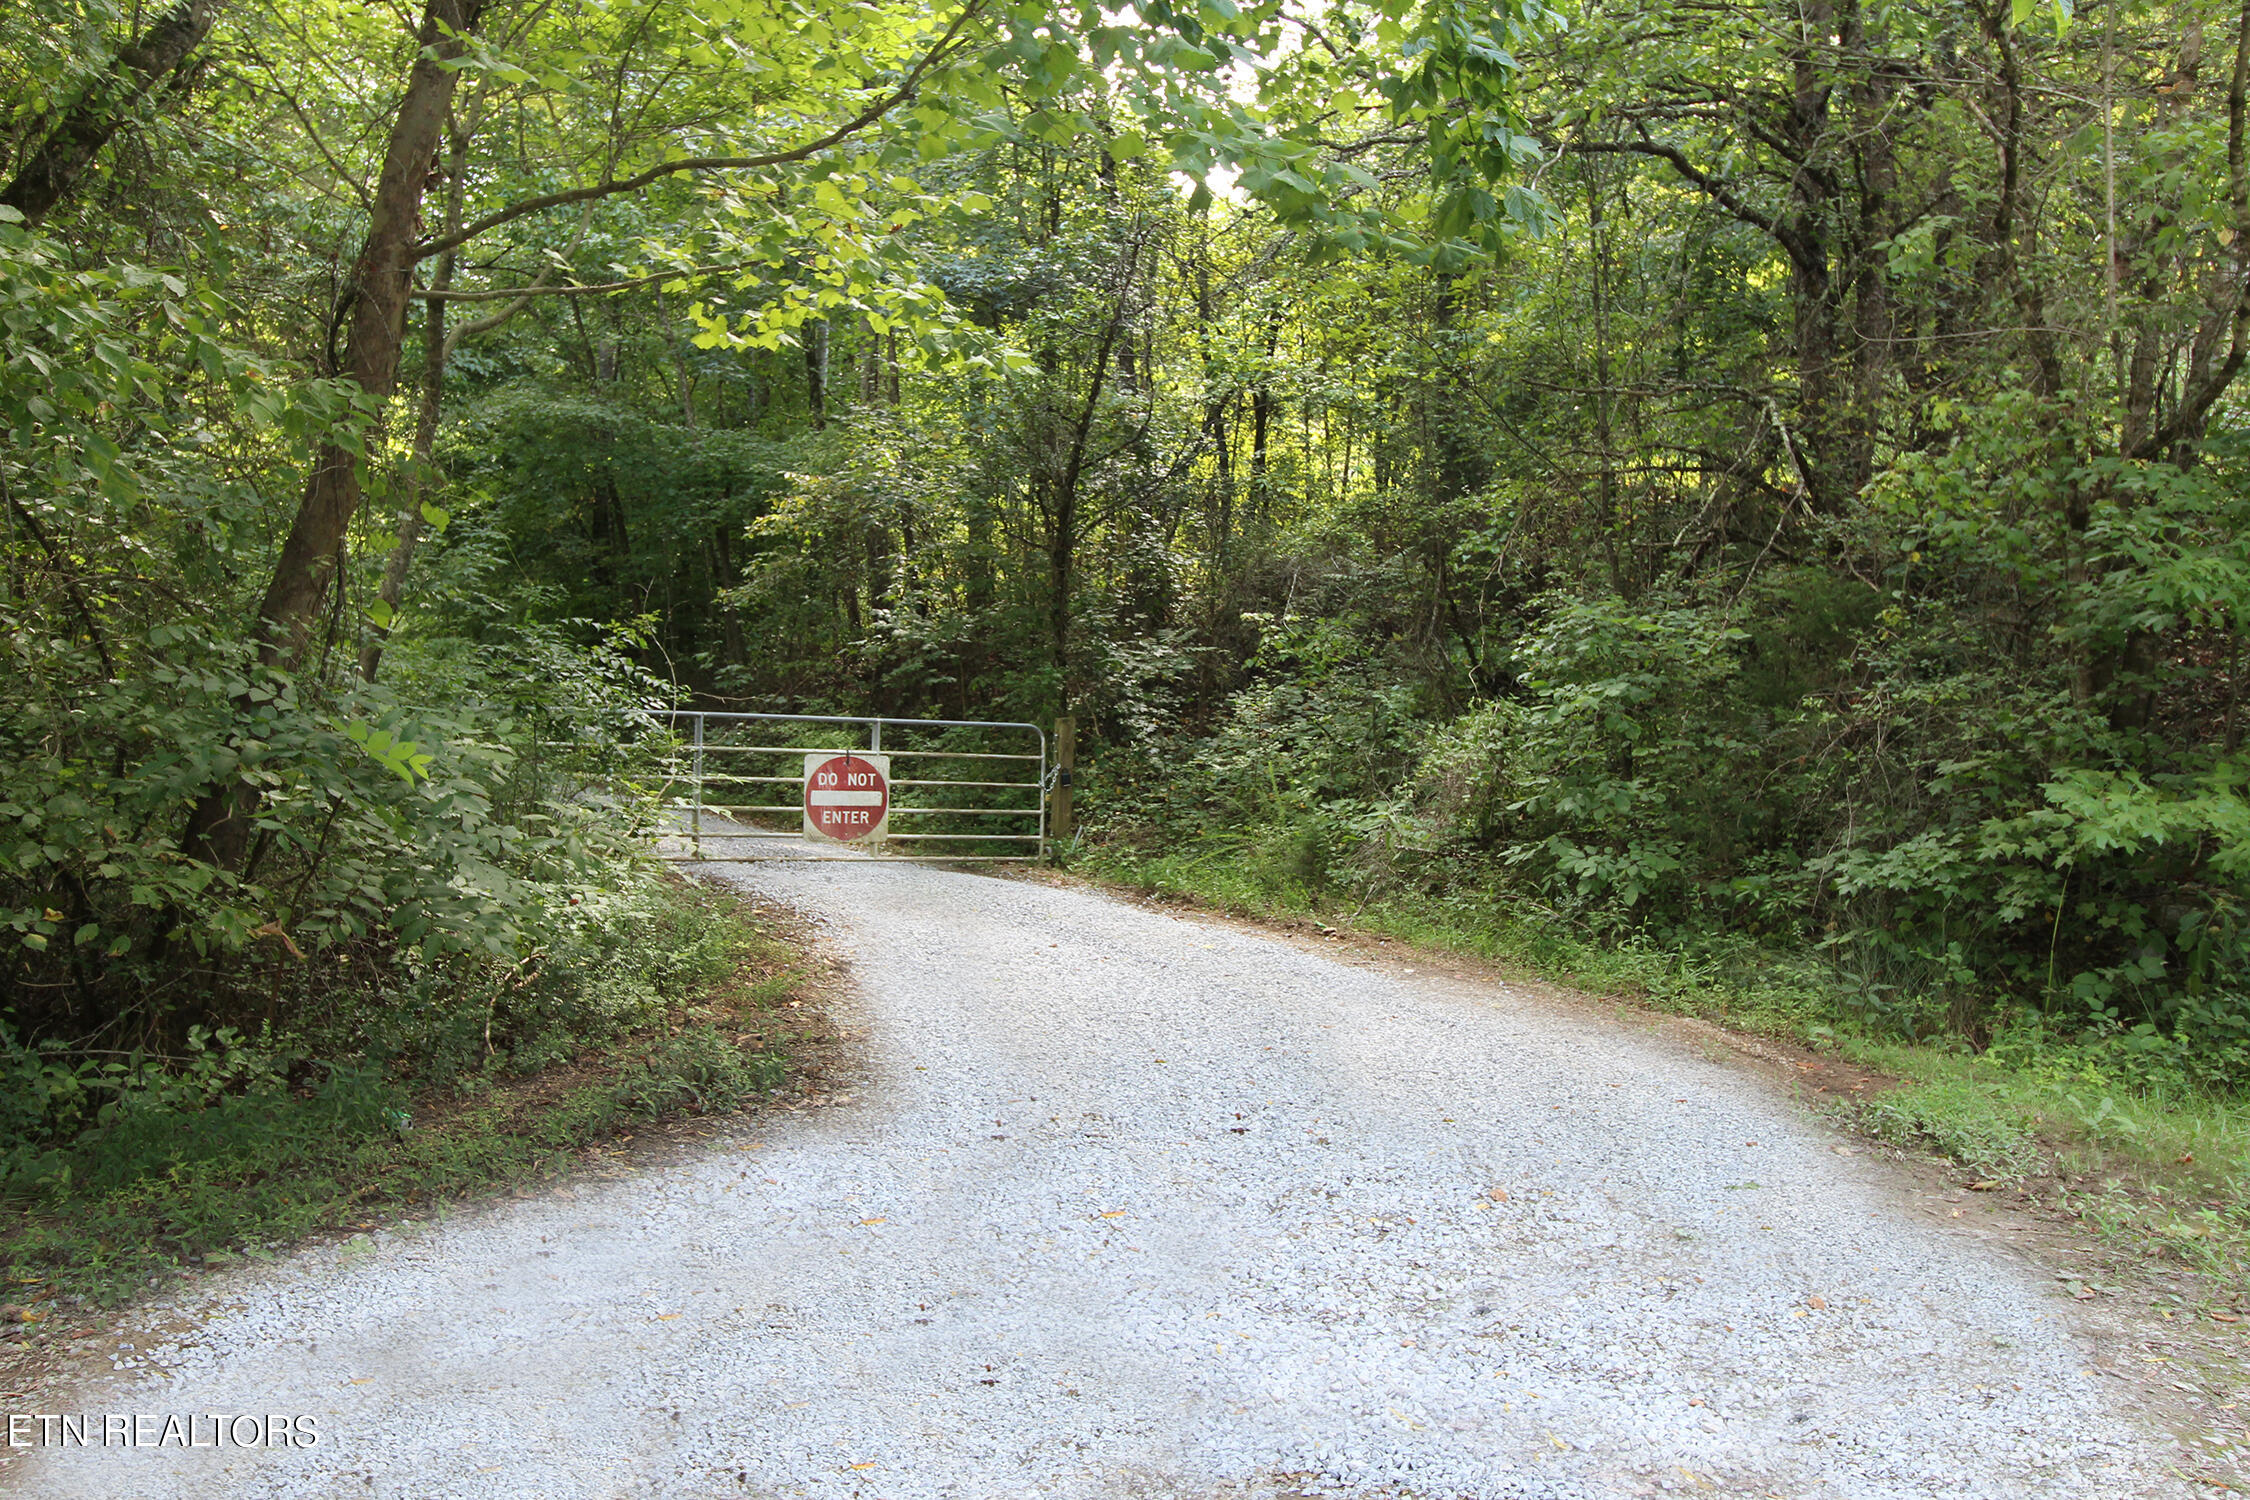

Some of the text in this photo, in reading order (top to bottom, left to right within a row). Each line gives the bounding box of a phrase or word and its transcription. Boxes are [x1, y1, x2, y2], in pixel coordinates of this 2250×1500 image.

[818, 772, 877, 786] DO NOT
[823, 811, 870, 824] ENTER
